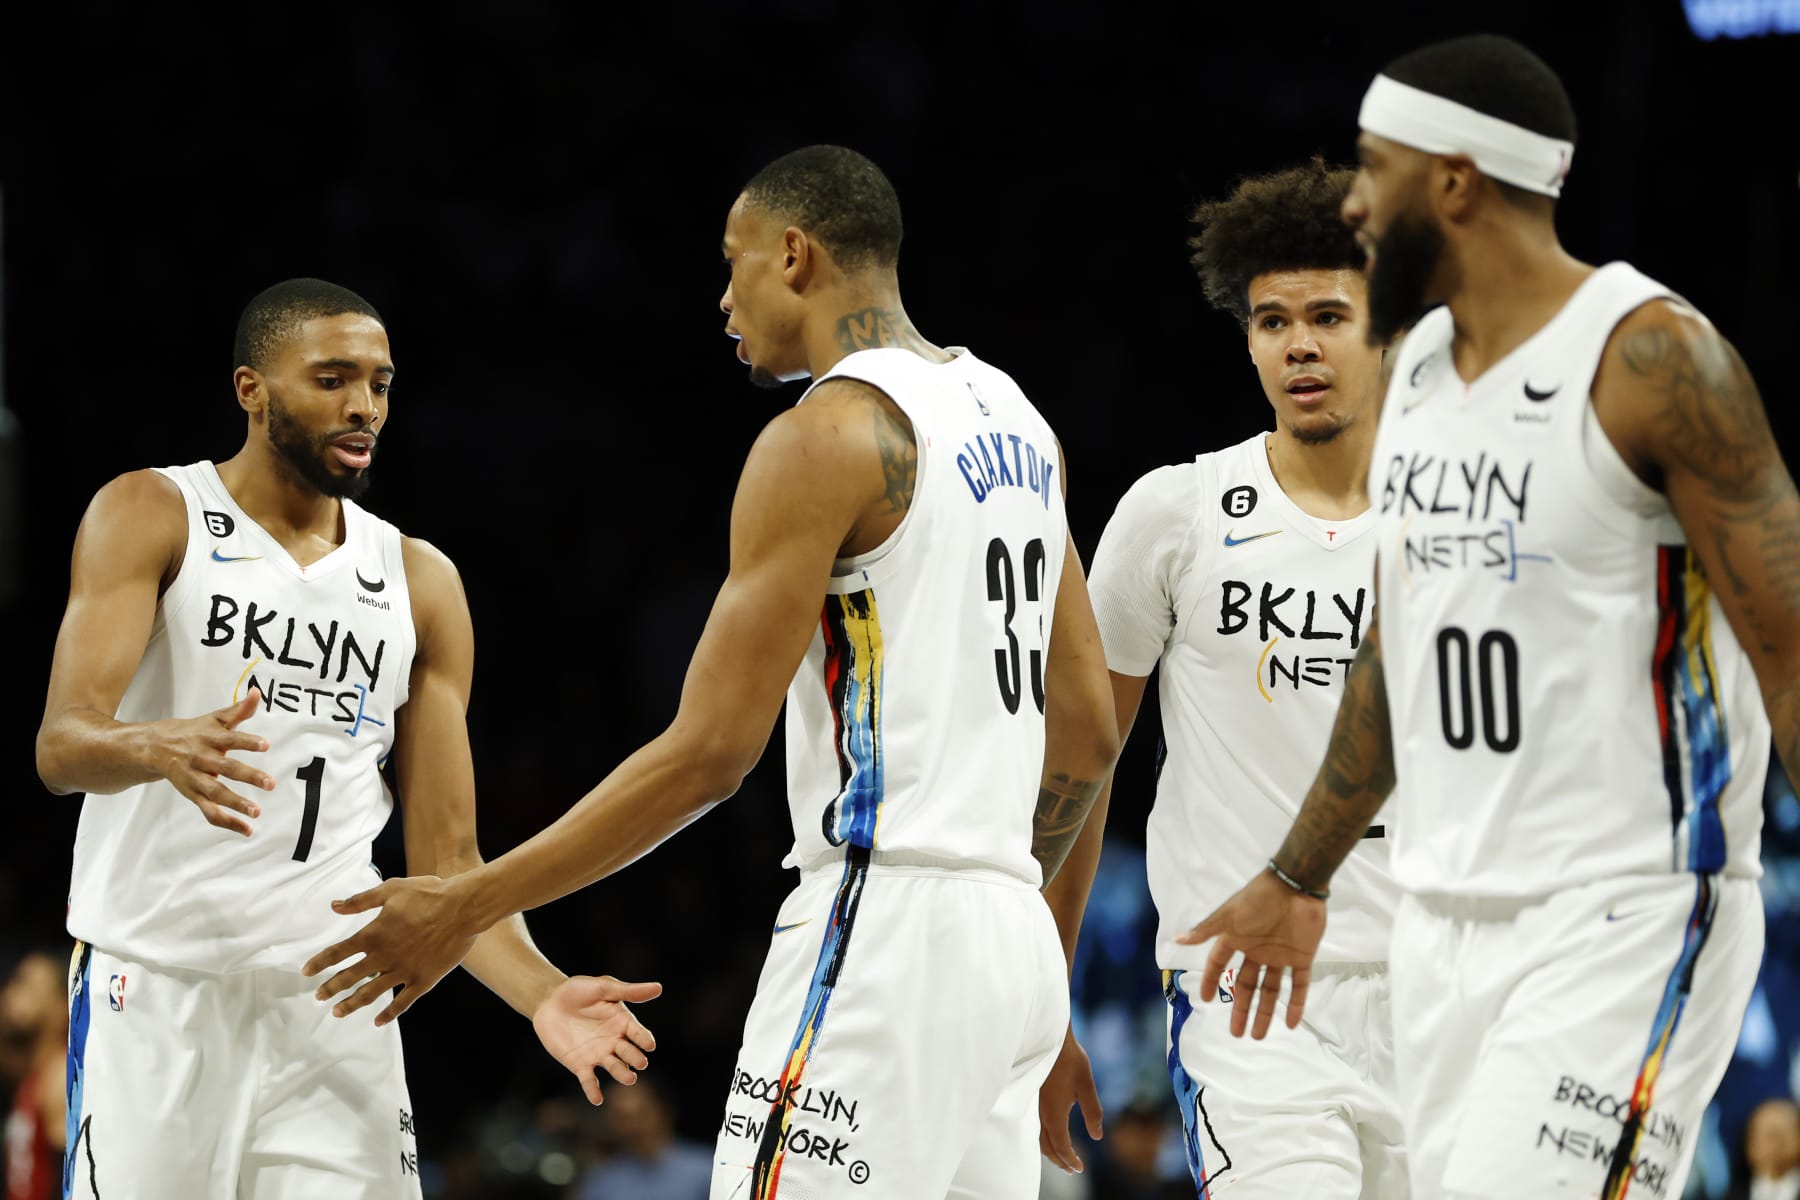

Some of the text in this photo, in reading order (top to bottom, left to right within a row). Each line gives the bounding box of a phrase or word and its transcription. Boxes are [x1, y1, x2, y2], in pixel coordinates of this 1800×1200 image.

[957, 432, 1053, 511] CLAXTON
[1230, 489, 1250, 515] 6
[1380, 450, 1534, 524] BKLYN
[207, 514, 227, 536] 6
[1404, 530, 1506, 573] NETS
[356, 593, 390, 612] Webull
[986, 537, 1046, 716] 33
[1216, 580, 1366, 650] BKLY
[201, 594, 386, 693] BKLYN
[1269, 654, 1353, 691] NET
[247, 674, 359, 723] NETS
[1436, 626, 1520, 754] 00
[291, 755, 326, 863] 1
